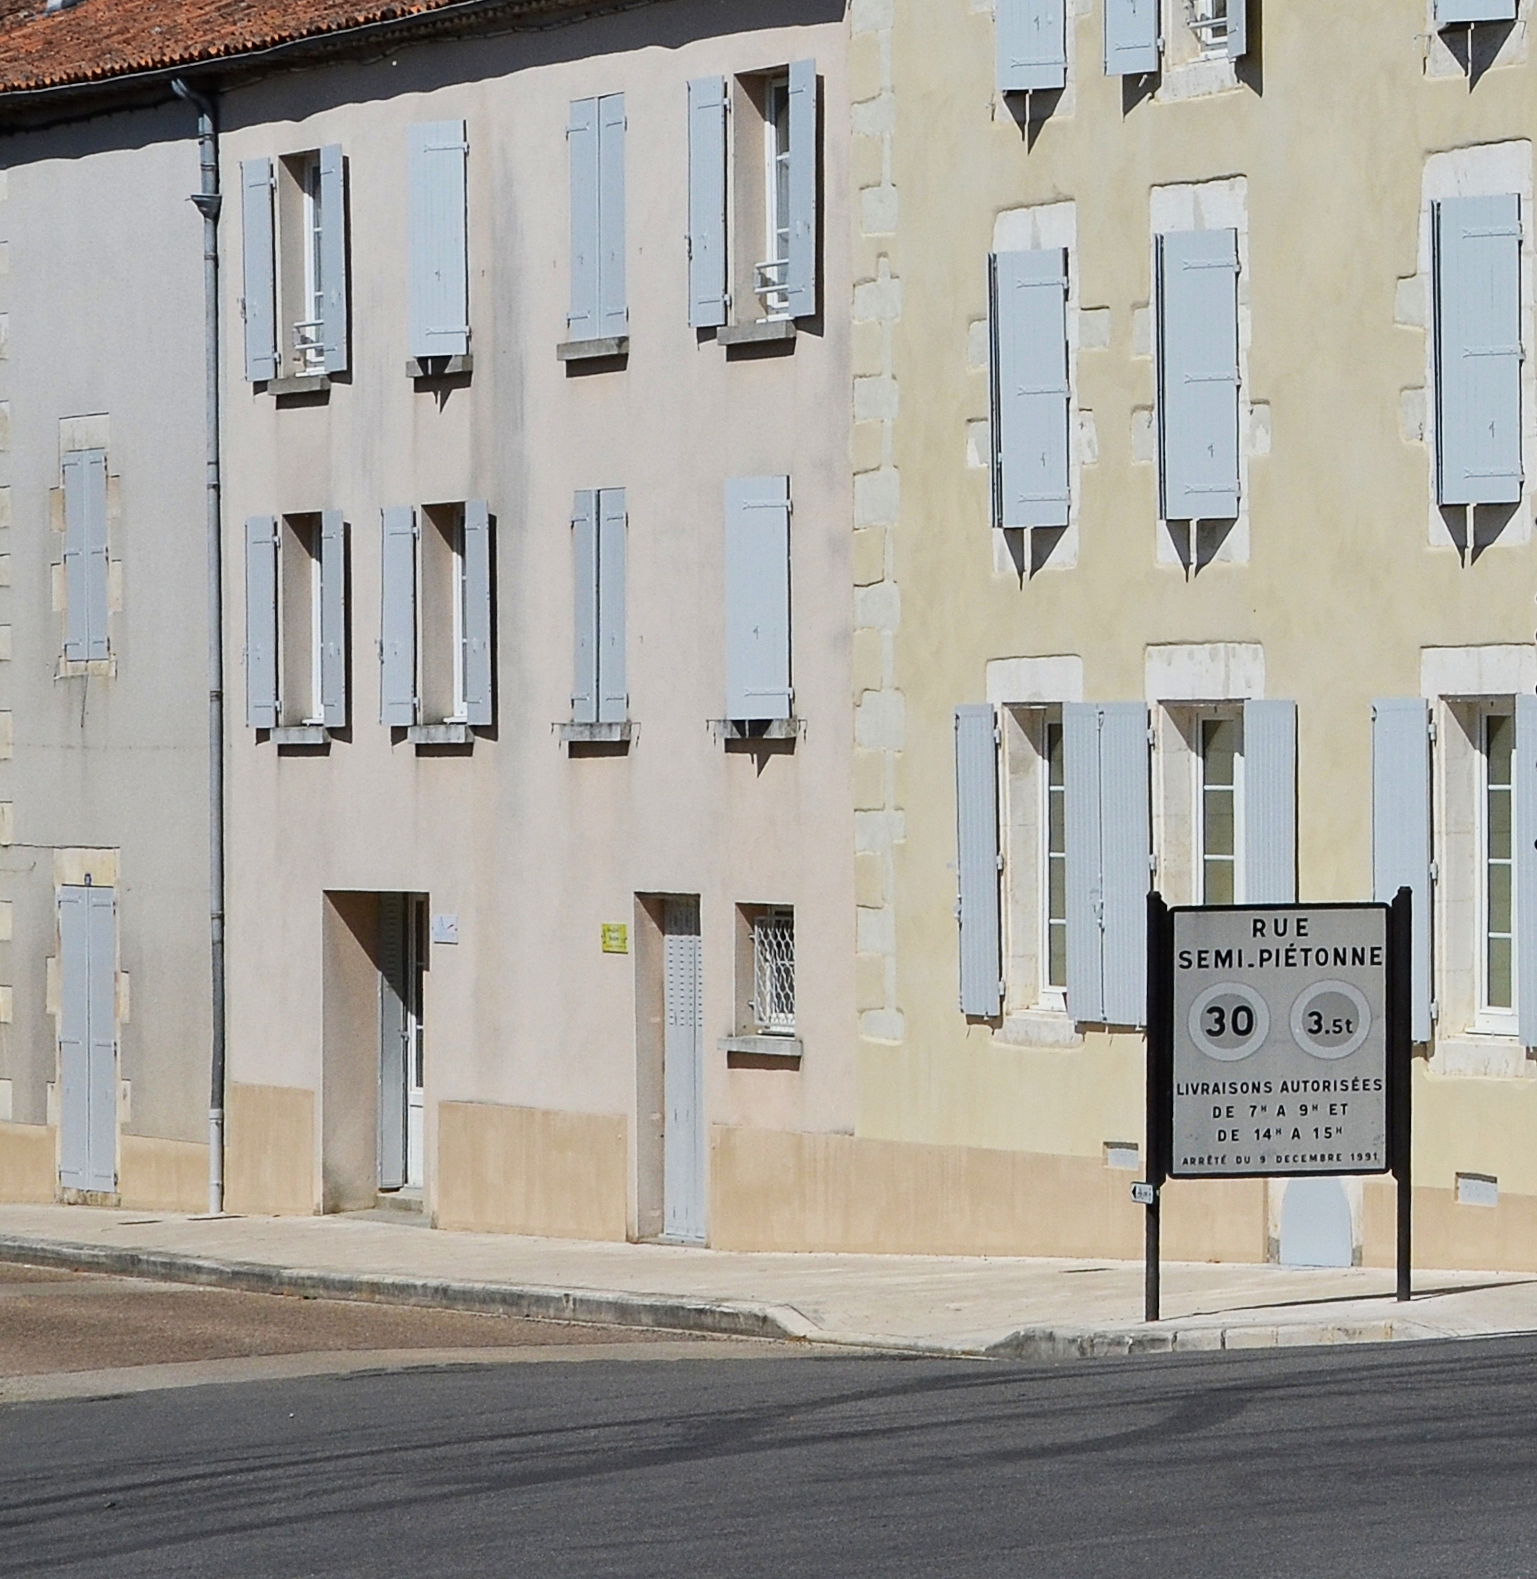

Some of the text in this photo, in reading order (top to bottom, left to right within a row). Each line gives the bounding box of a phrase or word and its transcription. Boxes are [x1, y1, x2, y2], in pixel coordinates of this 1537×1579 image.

[1252, 918, 1309, 937] RUE
[1205, 1005, 1254, 1037] 30
[1307, 1011, 1353, 1035] 3.5t
[1177, 1077, 1383, 1096] LIVRAISONS AUTORISÉES
[1212, 1106, 1235, 1118] DE
[1277, 1105, 1286, 1117] A
[1330, 1104, 1348, 1115] ET
[1218, 1129, 1240, 1142] DE
[1292, 1128, 1301, 1140] A
[1182, 1152, 1378, 1166] ARRÊTÉ DU 9 DECEMBRE 1991
